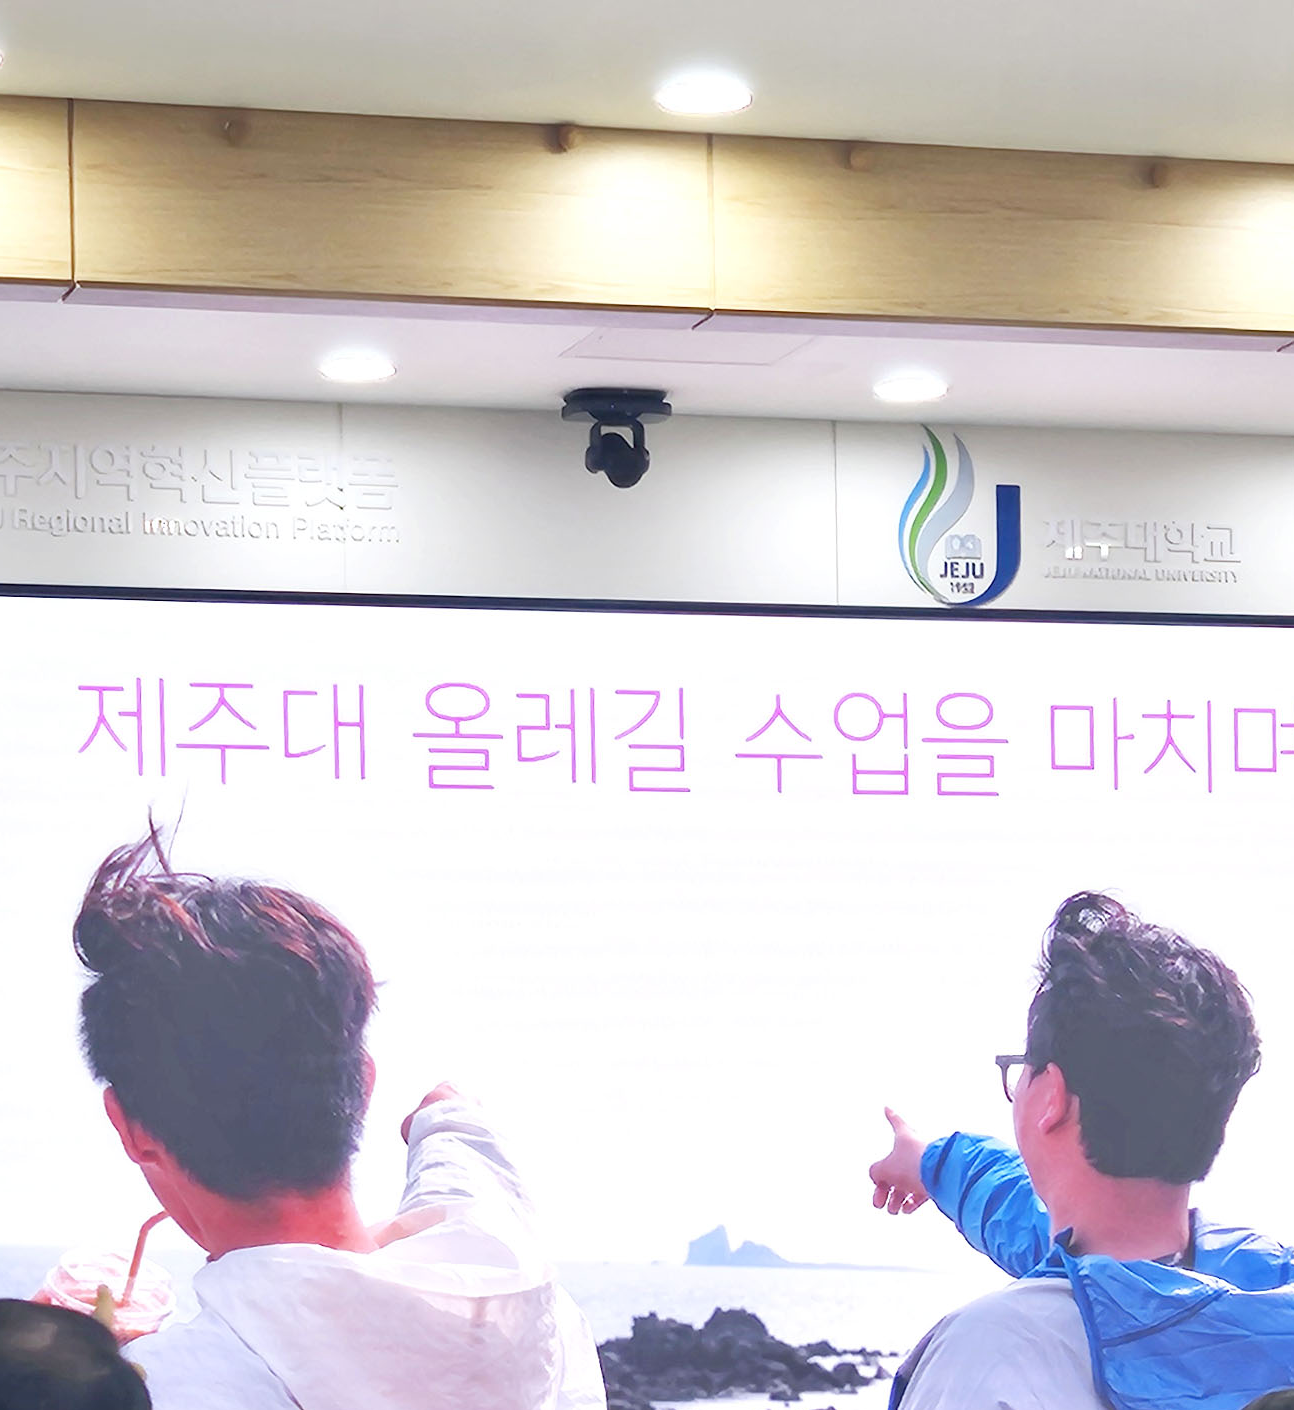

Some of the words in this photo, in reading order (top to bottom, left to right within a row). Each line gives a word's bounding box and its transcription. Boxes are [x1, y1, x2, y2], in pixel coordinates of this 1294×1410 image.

[12, 508, 131, 538] Regional
[1042, 519, 1242, 565] 제주대학교
[938, 560, 985, 580] JEJU
[1154, 568, 1239, 584] UNIVERSITY
[77, 676, 367, 785] 제주대
[412, 682, 692, 793] 올레길
[734, 692, 1010, 797] 수업을
